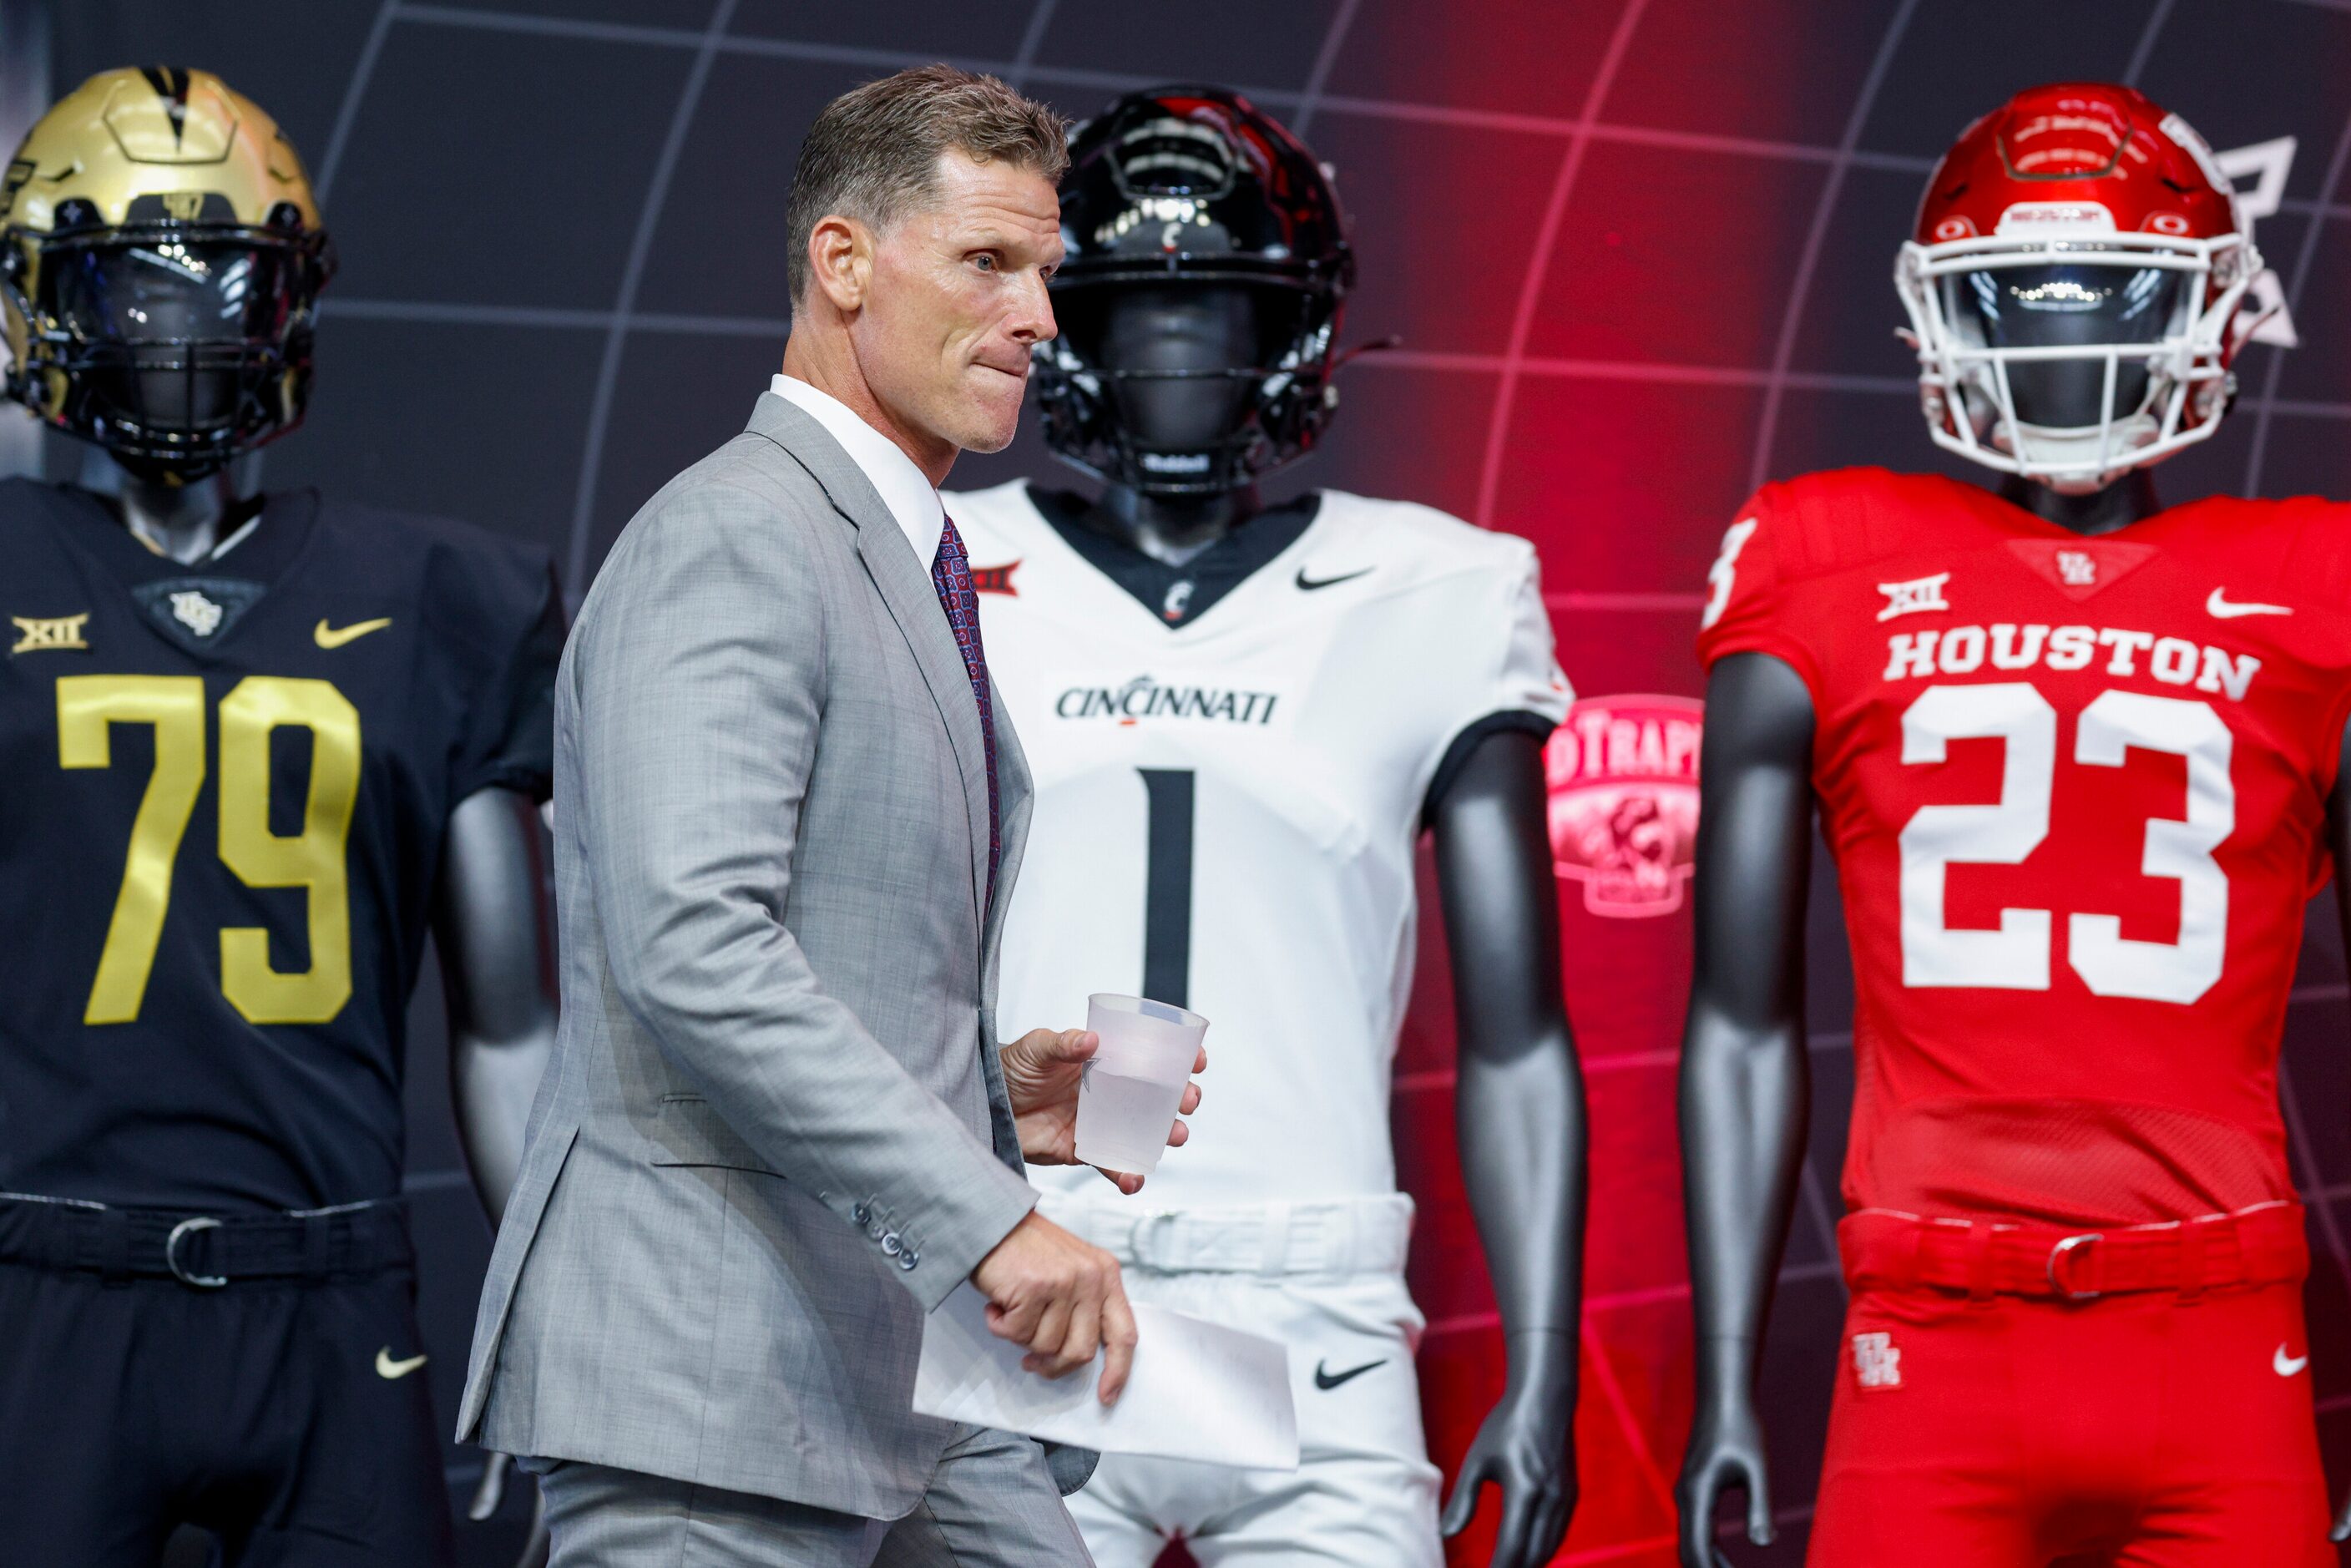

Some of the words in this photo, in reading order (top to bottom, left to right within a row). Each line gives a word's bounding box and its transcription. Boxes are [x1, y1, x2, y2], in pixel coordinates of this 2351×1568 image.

[12, 612, 88, 654] XII
[1877, 573, 1950, 621] XII
[1055, 675, 1278, 725] CINCINNATI
[1884, 624, 2262, 701] HOUSTON
[57, 675, 361, 1024] 79
[1898, 682, 2235, 1005] 23
[1135, 767, 1196, 1012] 1
